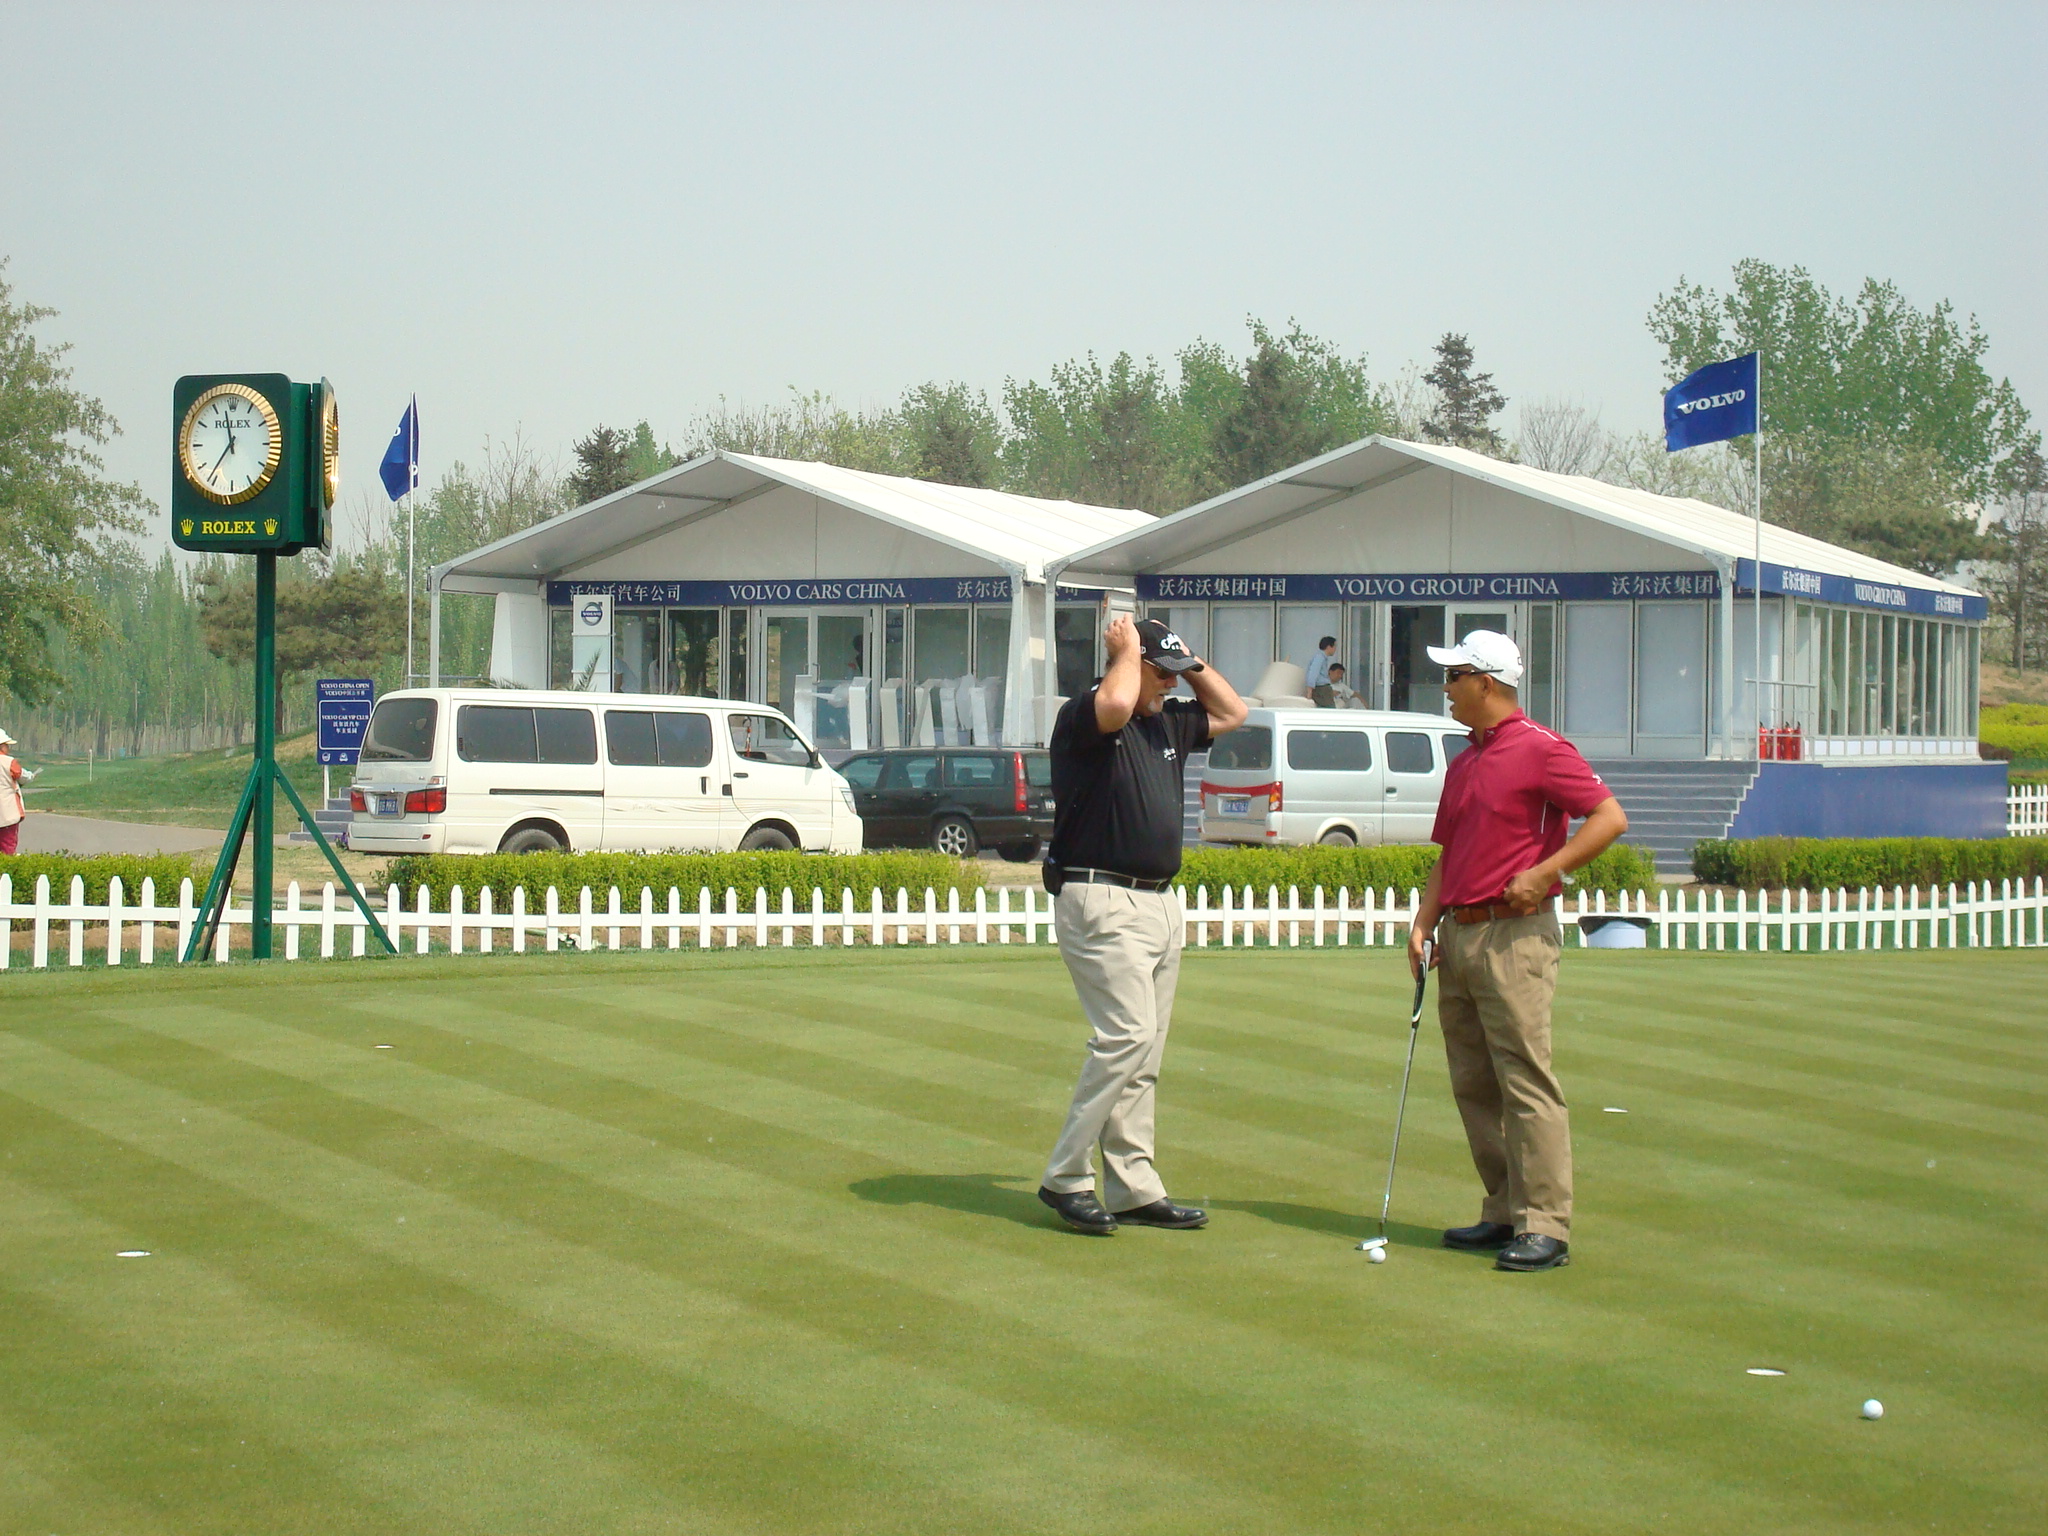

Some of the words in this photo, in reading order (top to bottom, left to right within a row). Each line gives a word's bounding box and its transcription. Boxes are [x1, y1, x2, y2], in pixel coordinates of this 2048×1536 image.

[1677, 389, 1746, 414] VOLVO
[215, 419, 251, 429] ROLEX
[201, 520, 256, 534] ROLEX
[729, 584, 791, 600] VOLVO
[796, 583, 842, 600] CARS
[846, 583, 906, 599] CHINA
[957, 580, 1013, 599] 沃尔沃
[1159, 578, 1287, 597] 沃尔沃集团中国
[1334, 579, 1405, 596] VOLVO
[1410, 578, 1485, 596] GROUP
[1490, 578, 1560, 595] CHINA
